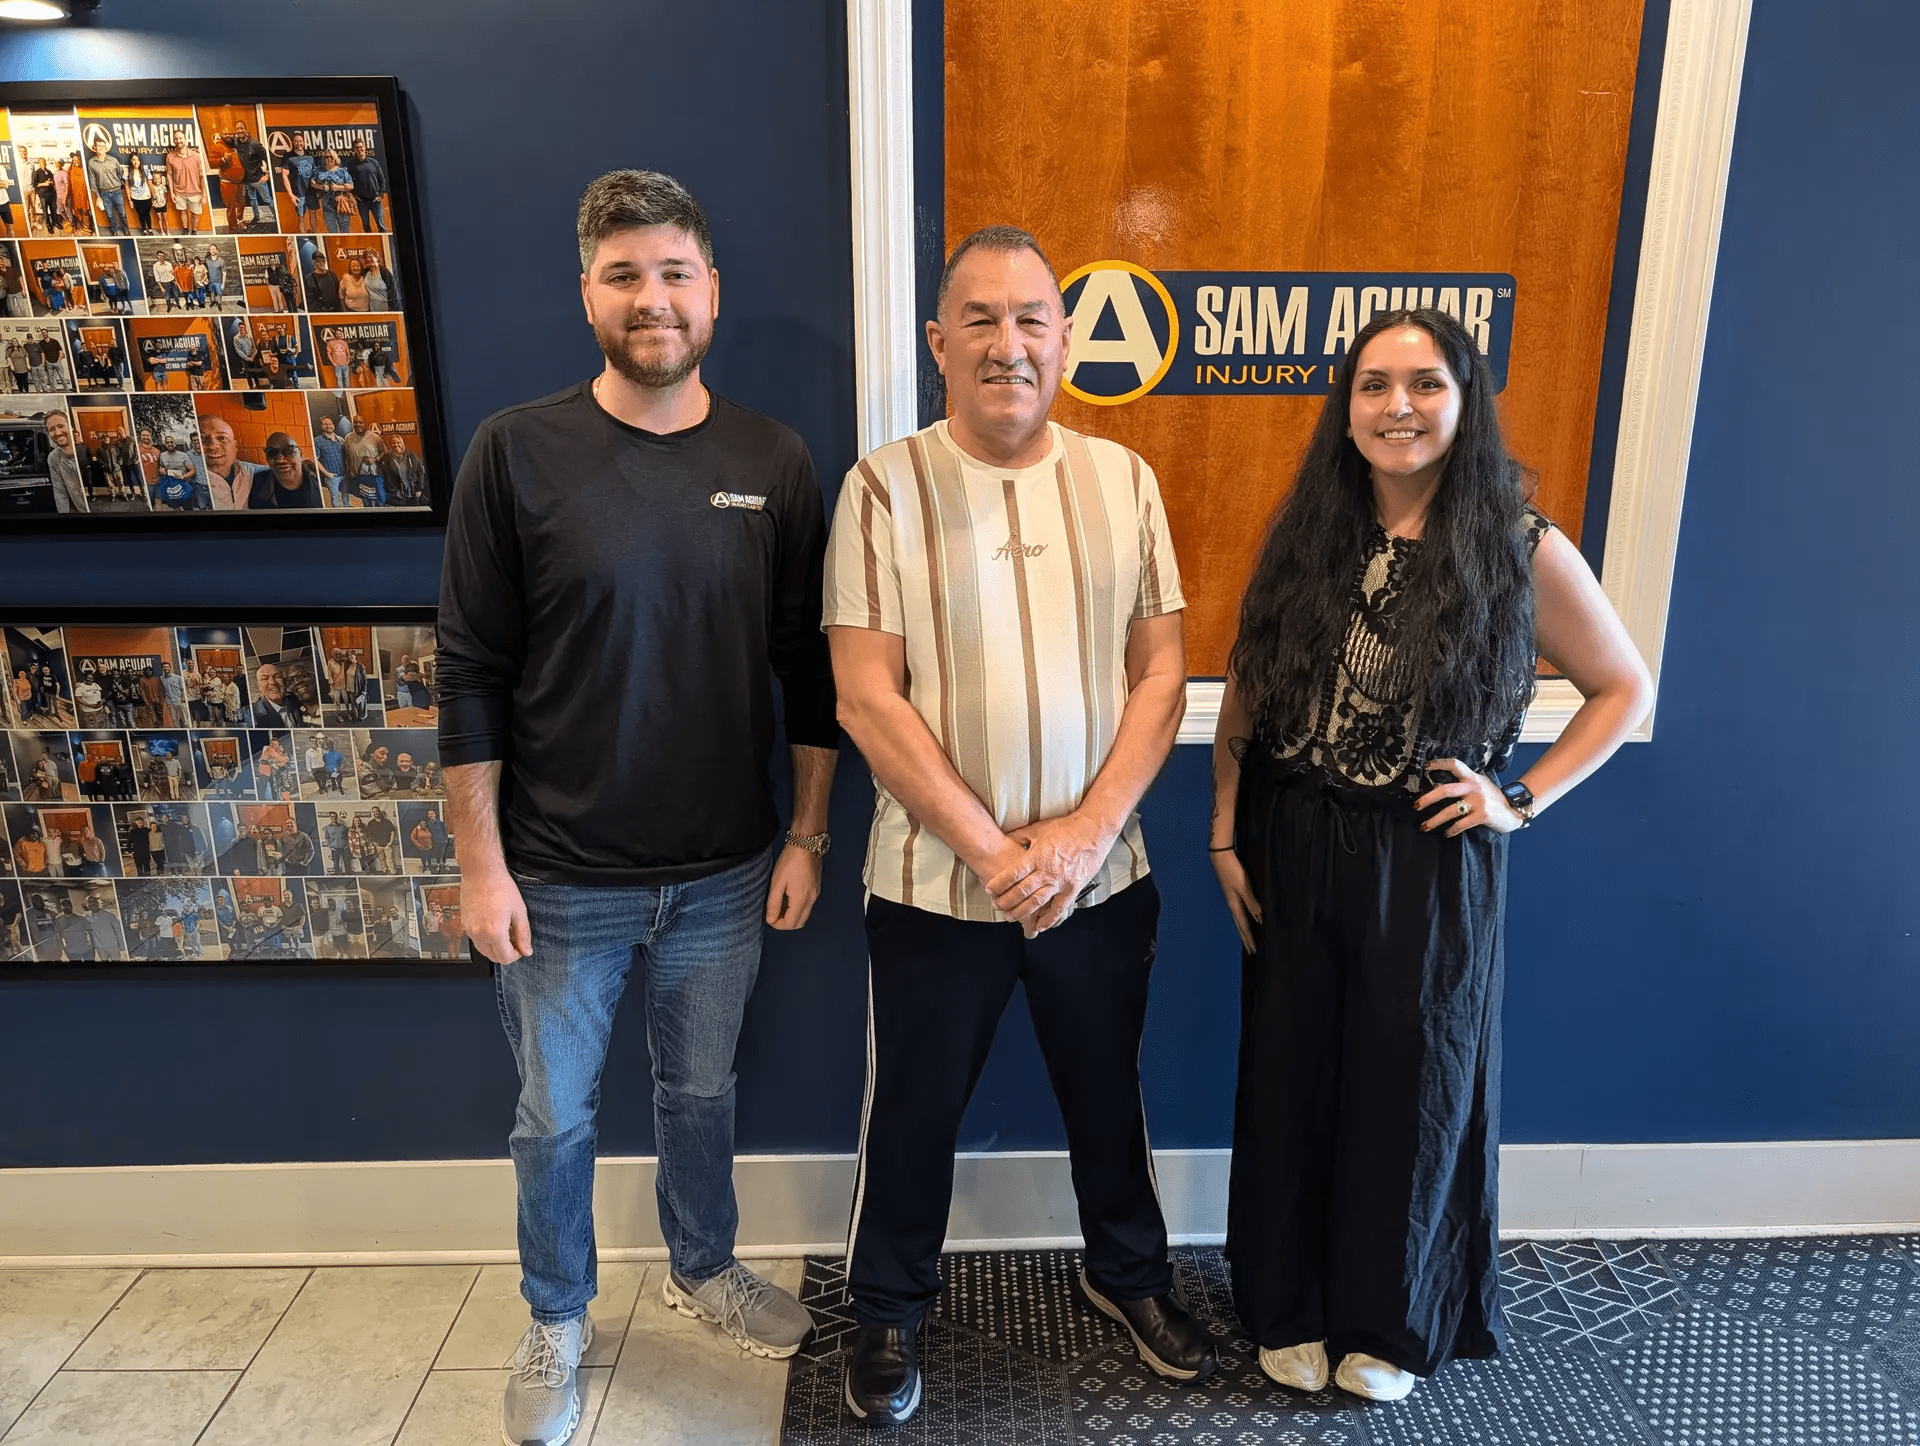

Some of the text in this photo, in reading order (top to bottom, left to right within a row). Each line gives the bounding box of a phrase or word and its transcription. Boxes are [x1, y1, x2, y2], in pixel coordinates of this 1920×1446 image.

[113, 123, 147, 147] SAM
[294, 130, 324, 150] AM
[358, 325, 389, 338] AGUIAR
[1194, 286, 1309, 356] SAM
[1195, 364, 1318, 386] INJURY
[729, 493, 745, 504] SAM
[991, 531, 1048, 561] Aero
